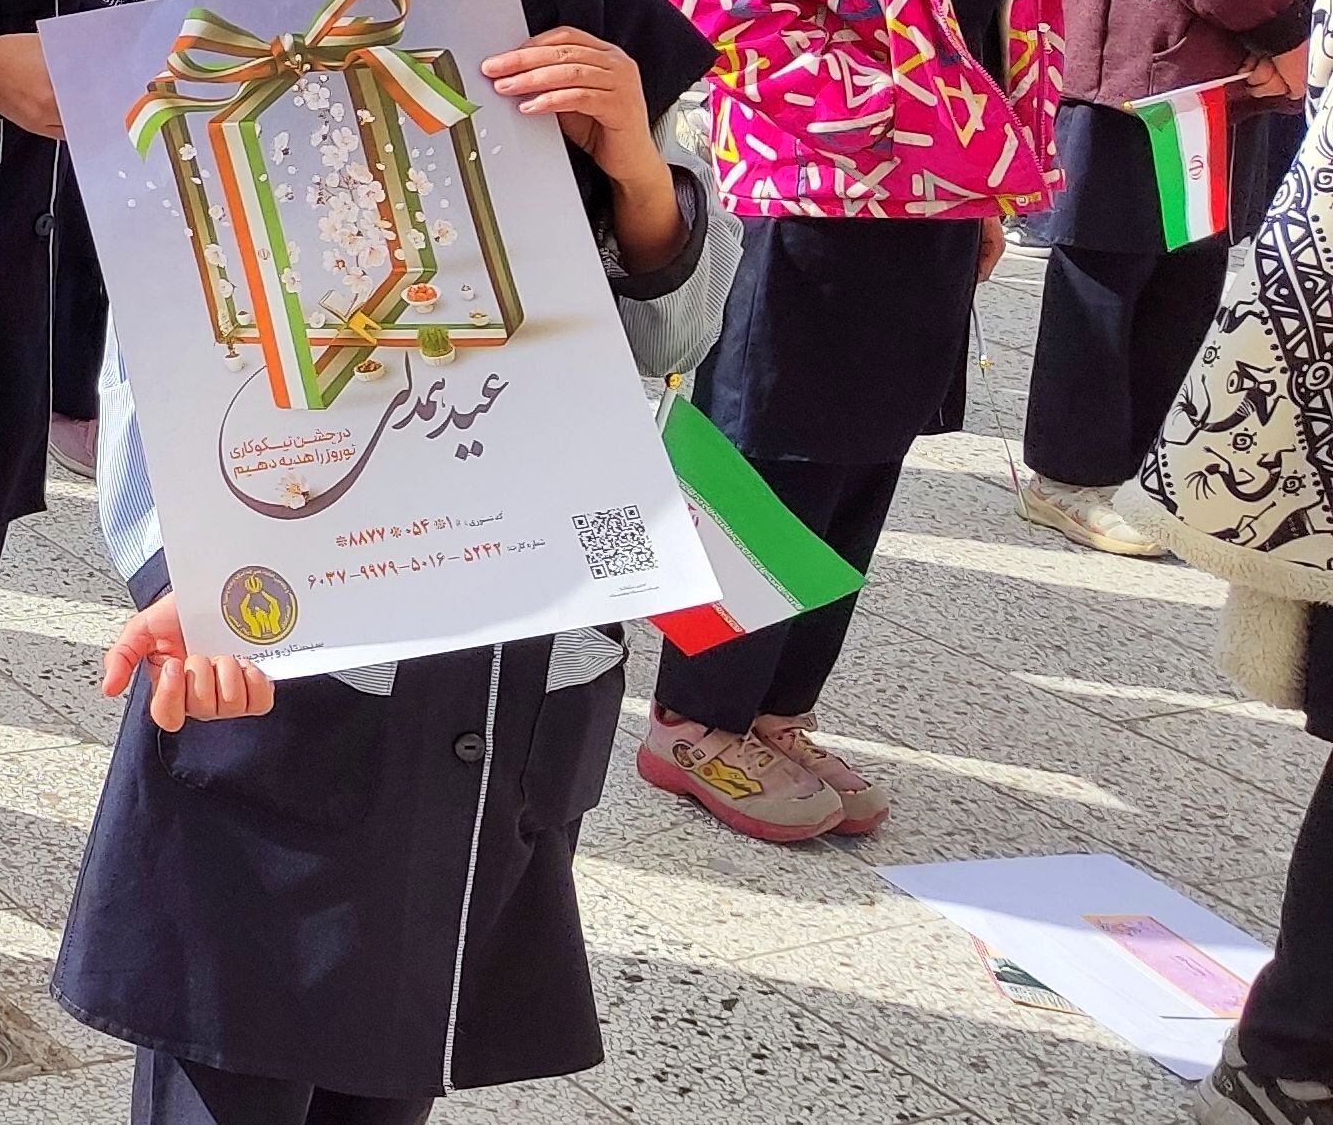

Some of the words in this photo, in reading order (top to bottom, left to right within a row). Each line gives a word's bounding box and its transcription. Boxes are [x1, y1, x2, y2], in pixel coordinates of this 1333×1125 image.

[425, 373, 510, 461] عید
[293, 428, 336, 449] جشن
[337, 427, 352, 444] در
[229, 436, 293, 460] نیکوکاری
[315, 448, 325, 465] را
[325, 443, 356, 464] نوروز
[233, 458, 277, 480] دهیم
[278, 453, 314, 470] هدیه
